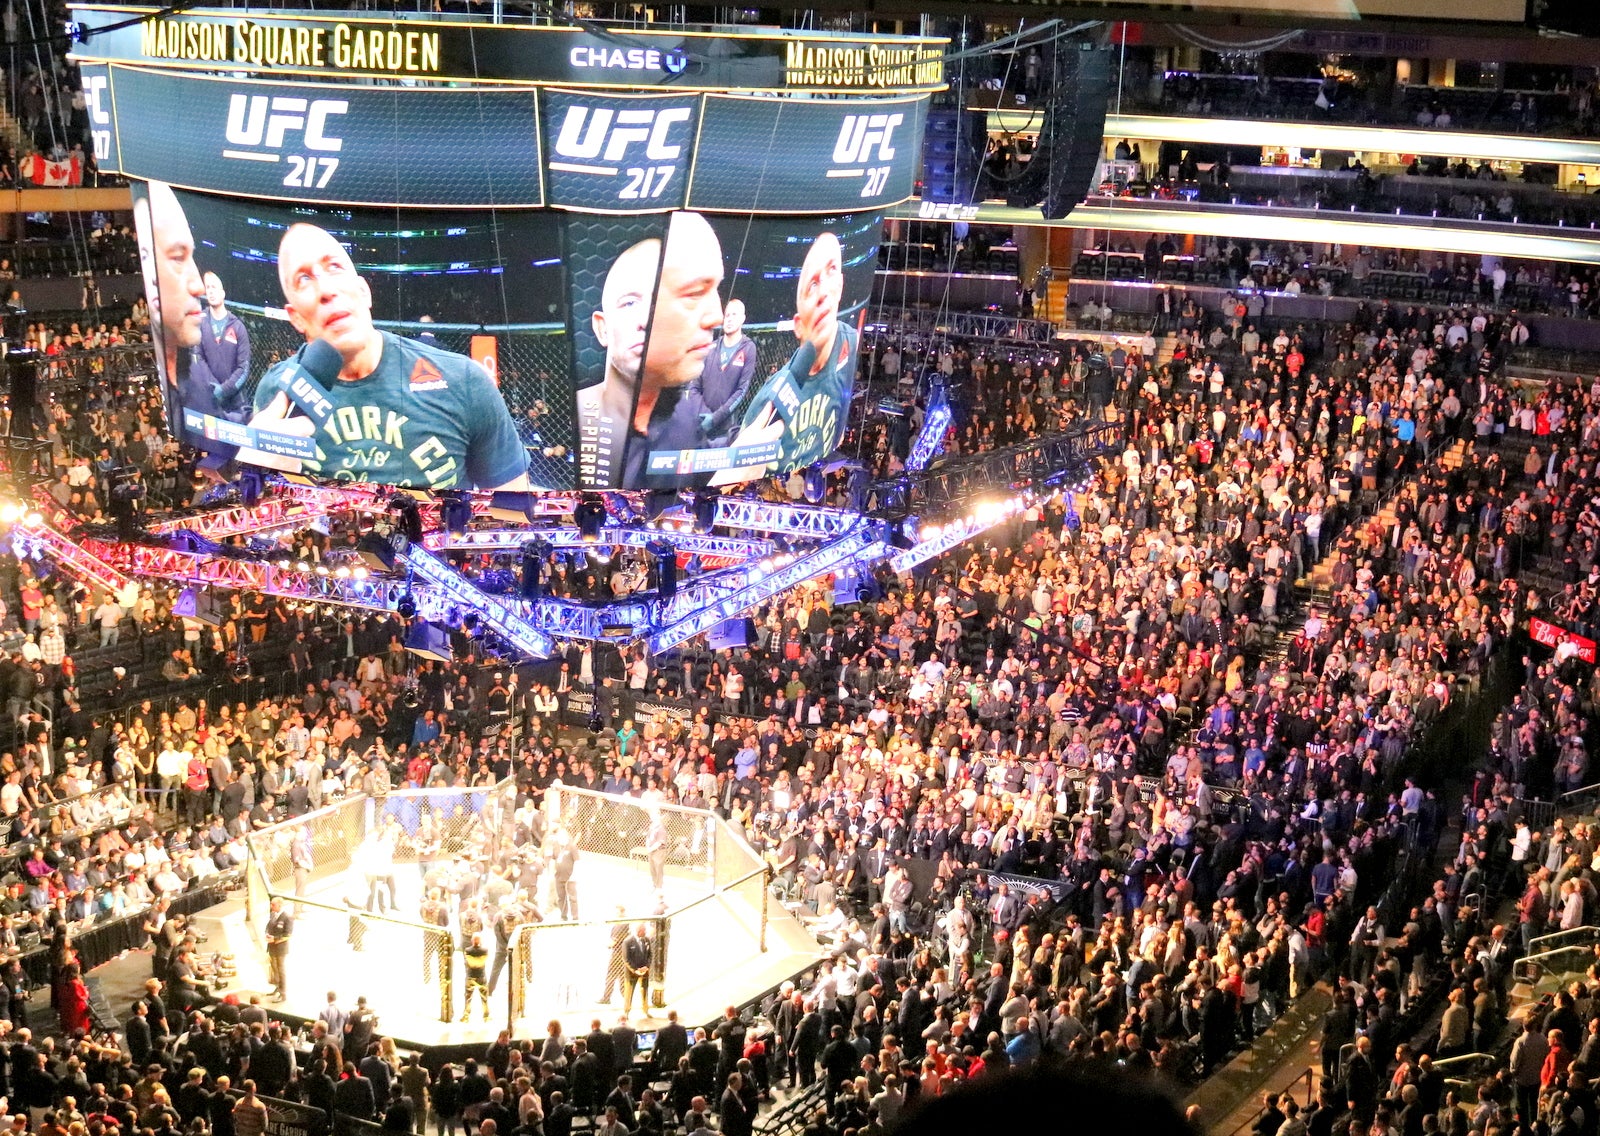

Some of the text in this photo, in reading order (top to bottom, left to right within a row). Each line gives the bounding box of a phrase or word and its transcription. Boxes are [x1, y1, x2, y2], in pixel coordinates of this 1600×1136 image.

[141, 19, 439, 71] MADISON SQUARE GARDEN
[570, 47, 661, 70] CHASE
[786, 41, 864, 85] MADISON
[867, 44, 914, 88] SQUARE
[226, 94, 348, 152] UFC
[555, 105, 691, 162] UFC
[833, 113, 903, 164] UFC
[283, 155, 340, 189] 217
[619, 165, 676, 199] 217
[860, 165, 891, 198] 217
[919, 201, 962, 220] UFC
[291, 377, 333, 418] UFC
[777, 382, 800, 417] UFC
[323, 406, 409, 449] YORK
[651, 457, 677, 468] UFC
